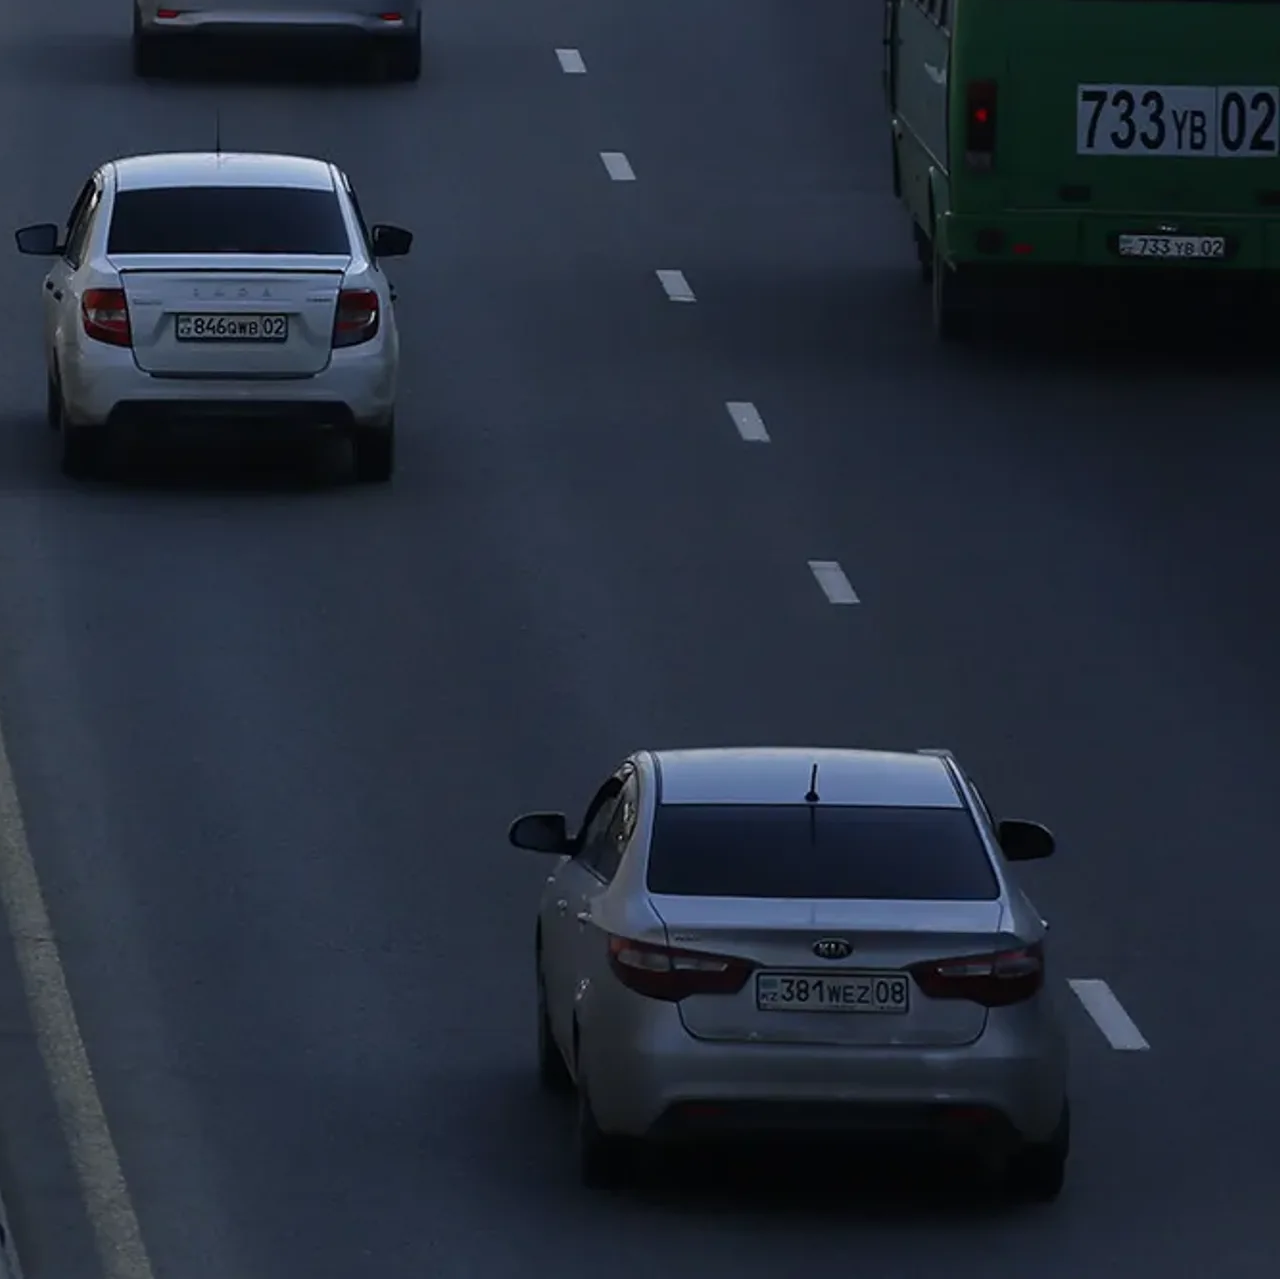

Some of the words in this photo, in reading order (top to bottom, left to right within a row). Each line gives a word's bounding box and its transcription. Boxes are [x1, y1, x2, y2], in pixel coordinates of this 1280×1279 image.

[1220, 91, 1277, 152] 02
[1200, 240, 1223, 257] 02
[262, 317, 284, 334] 02
[818, 942, 848, 956] KIA
[875, 979, 905, 1004] 08
